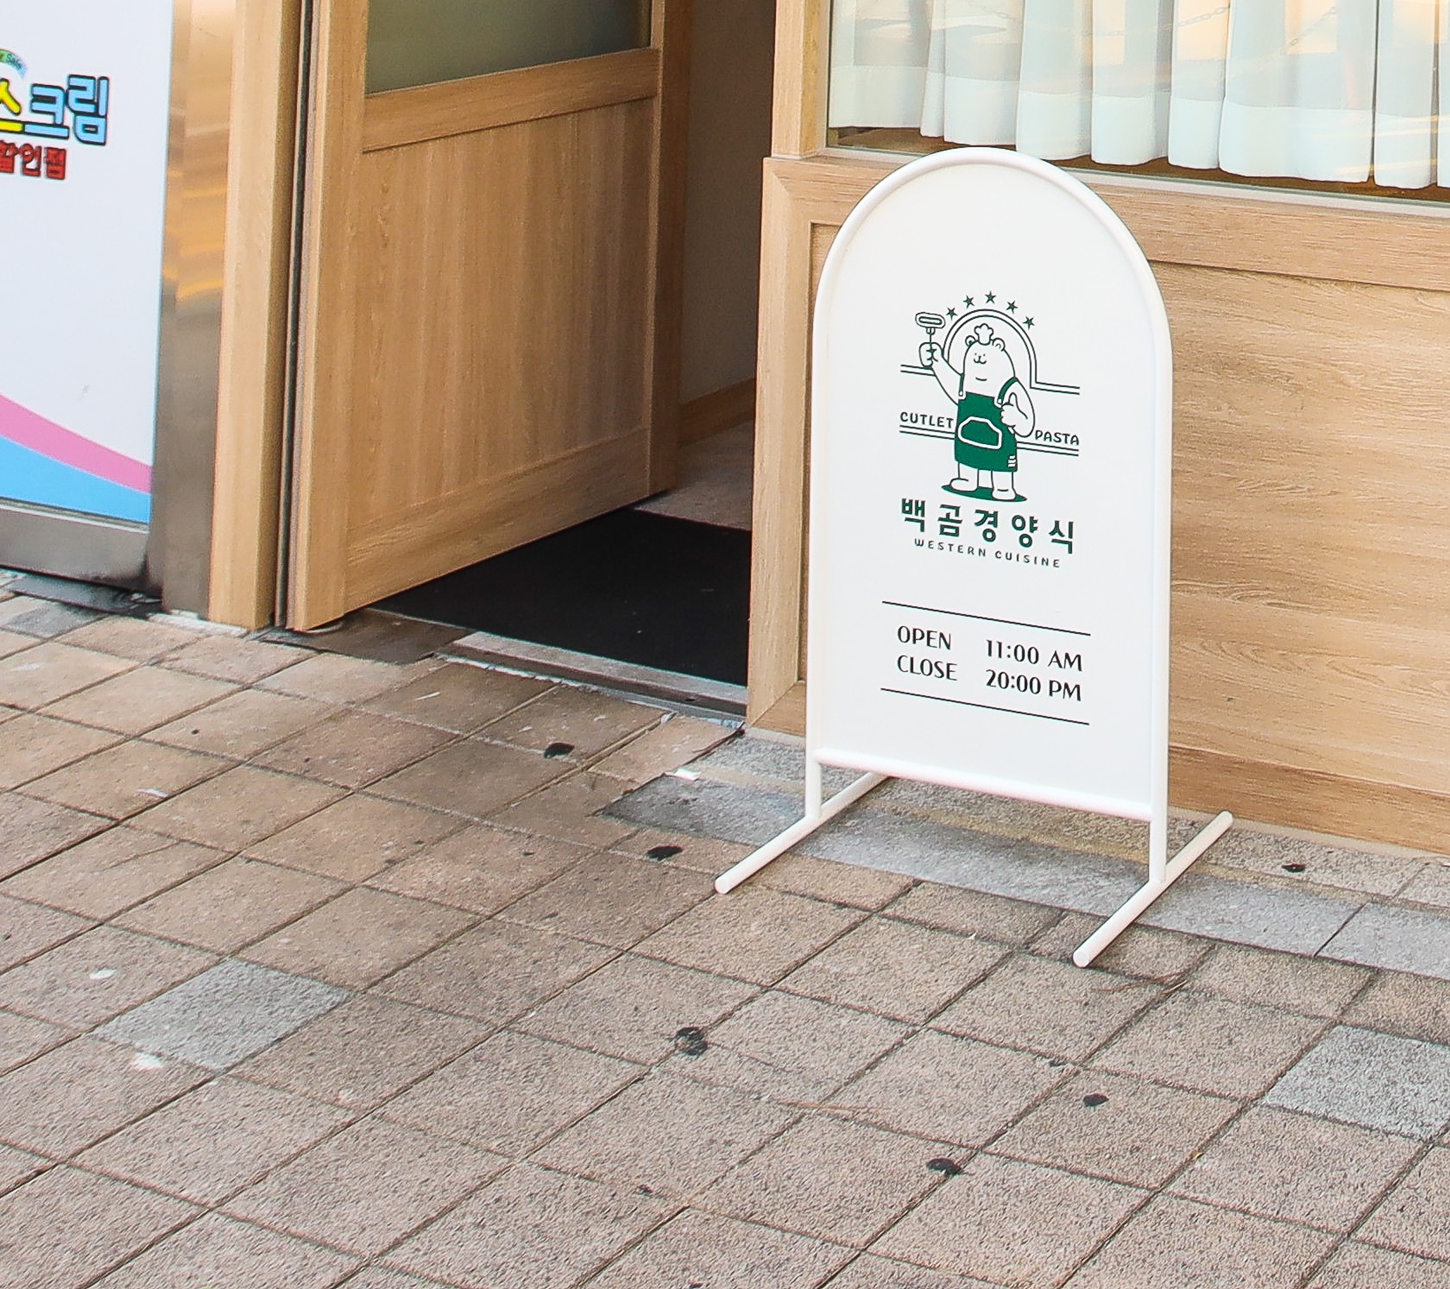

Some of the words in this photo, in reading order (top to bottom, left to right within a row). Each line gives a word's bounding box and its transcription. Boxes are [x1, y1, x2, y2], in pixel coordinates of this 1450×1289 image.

[900, 411, 955, 429] CUTLET
[1035, 429, 1080, 446] PASTA
[901, 498, 1074, 554] 백곰경양식
[914, 538, 986, 557] WESTERN
[995, 550, 1060, 568] CUISINE
[897, 625, 952, 651] OPEN
[986, 639, 1040, 665] 11:00
[1047, 650, 1083, 672] AM
[897, 654, 958, 681] CLOSE
[985, 669, 1041, 695] 20:00
[1049, 680, 1081, 702] PM
